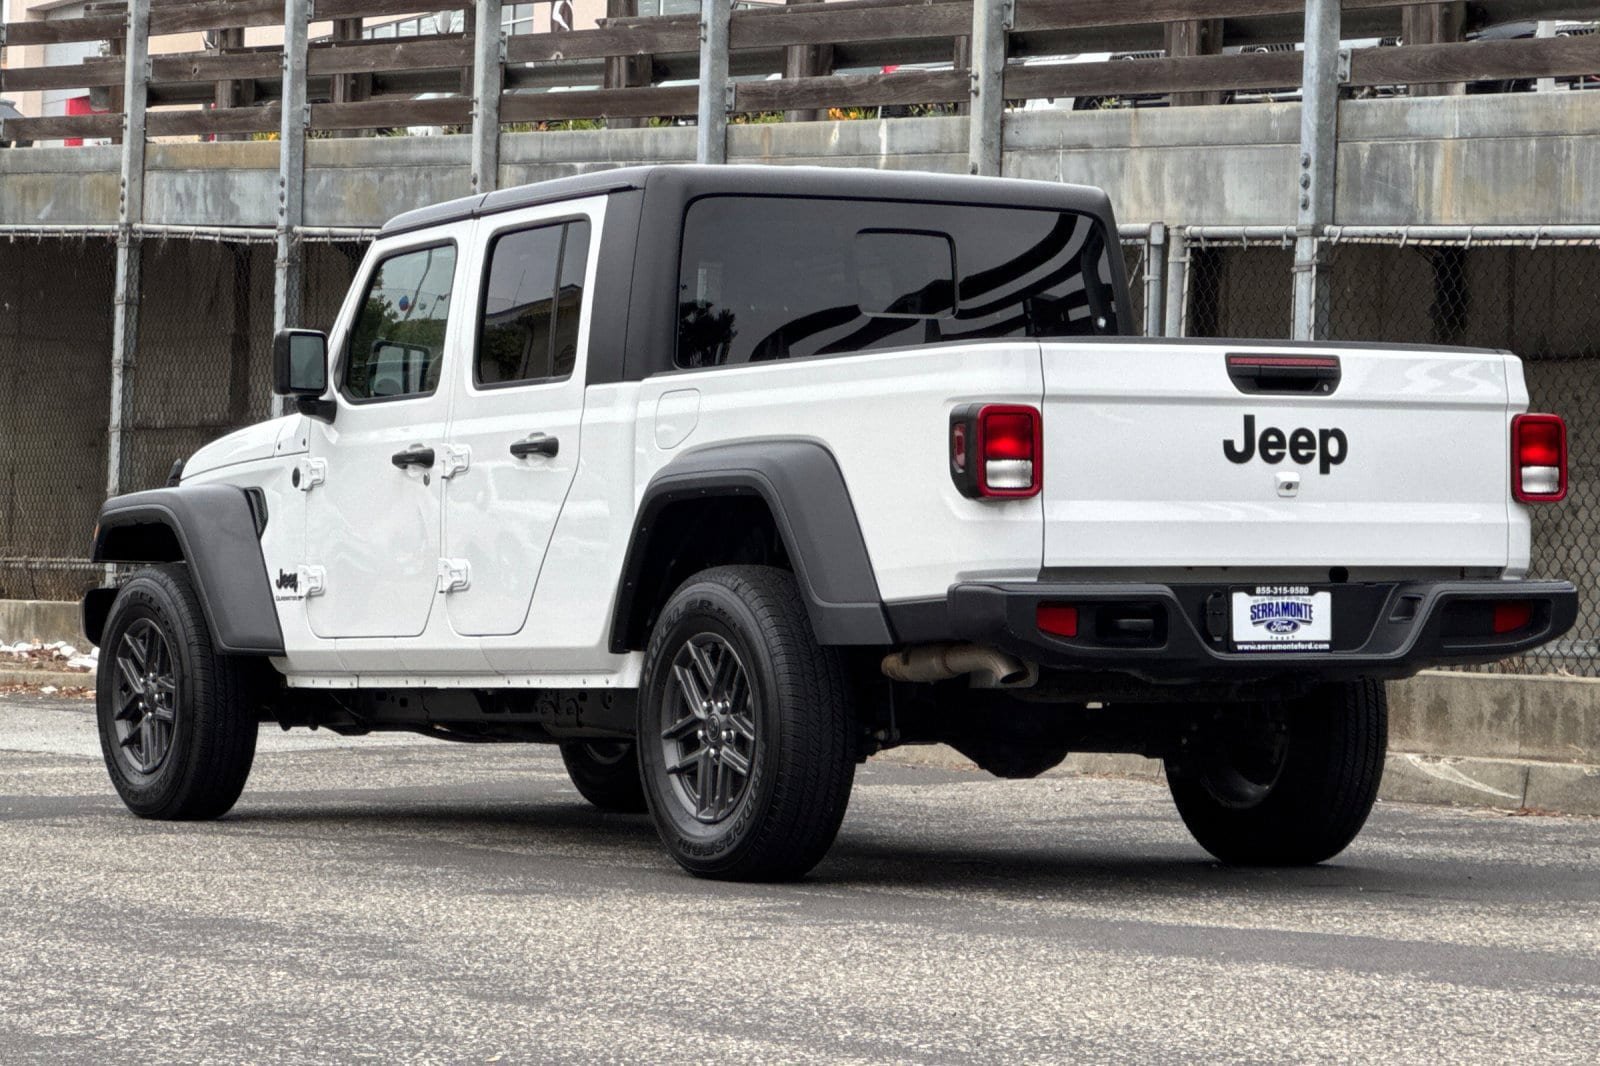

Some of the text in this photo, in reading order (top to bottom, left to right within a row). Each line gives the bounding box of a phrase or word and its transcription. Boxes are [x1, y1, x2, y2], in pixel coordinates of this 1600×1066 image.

[1223, 414, 1348, 475] Jeep
[276, 568, 298, 593] Jeep
[1250, 601, 1313, 621] SERRAMONTE
[1269, 620, 1294, 632] Ford
[1237, 642, 1330, 651] www.serramonteford.com
